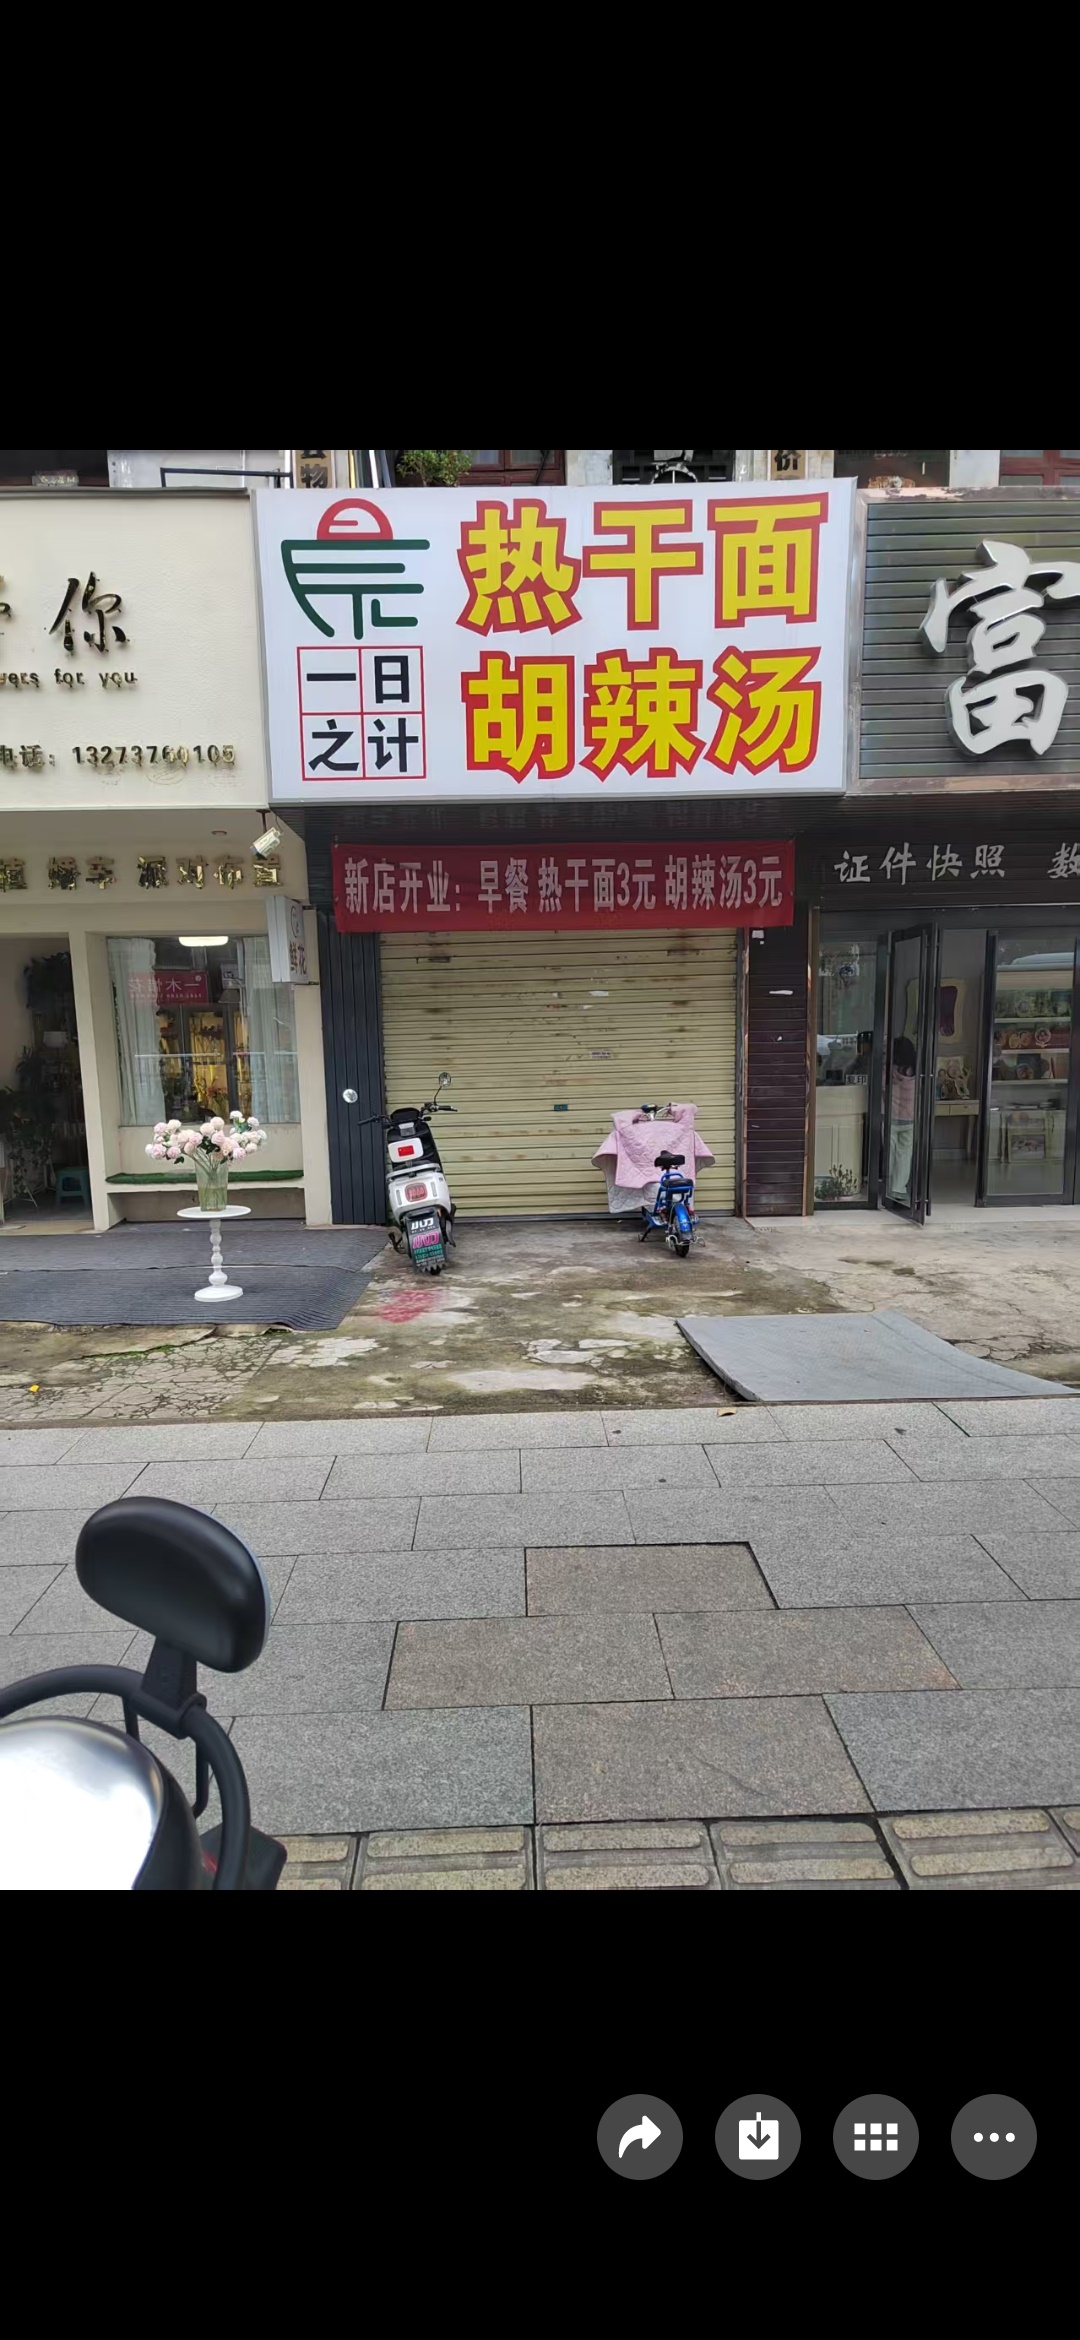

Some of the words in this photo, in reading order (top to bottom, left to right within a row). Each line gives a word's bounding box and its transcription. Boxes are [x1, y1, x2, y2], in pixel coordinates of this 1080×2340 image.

[457, 492, 830, 636] 热干面
[919, 539, 1080, 756] 富
[54, 668, 85, 687] for
[99, 672, 138, 689] you
[305, 654, 411, 705] 一日
[461, 644, 823, 783] 胡辣汤
[307, 716, 420, 773] 之计
[538, 856, 657, 914] 热干面3元
[664, 853, 784, 911] 胡辣汤3元
[833, 842, 1007, 886] 证件快照
